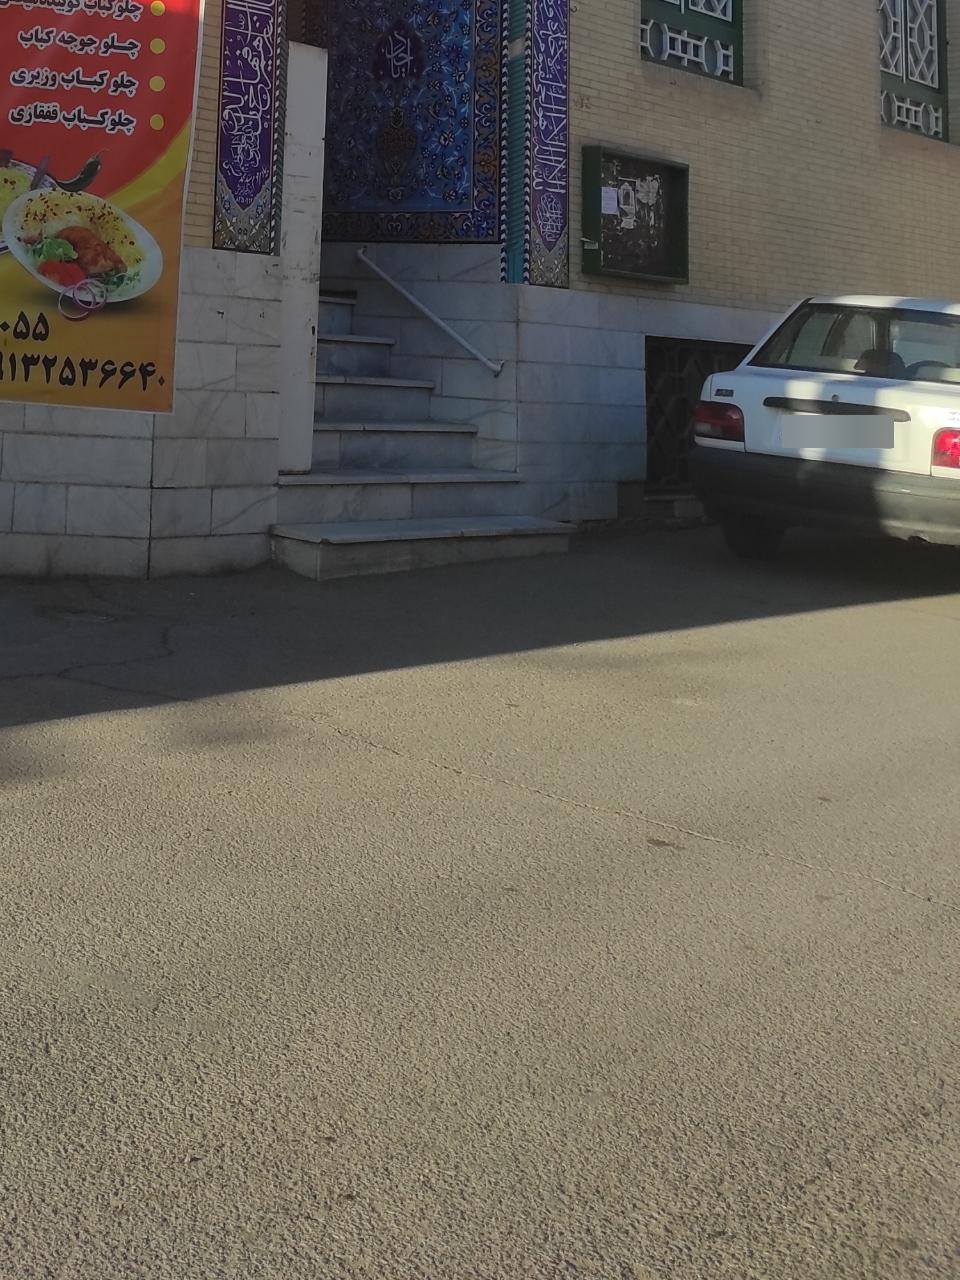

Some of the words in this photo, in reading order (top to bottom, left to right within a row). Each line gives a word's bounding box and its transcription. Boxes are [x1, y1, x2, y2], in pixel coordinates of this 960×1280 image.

[18, 25, 56, 49] کباب
[56, 30, 99, 55] جوجه
[99, 32, 141, 59] چلو
[10, 66, 58, 89] وزیری
[60, 67, 110, 93] کباب
[108, 71, 139, 97] چلو
[9, 102, 60, 126] قفقازی
[61, 106, 111, 130] کباب
[106, 110, 136, 136] چلو
